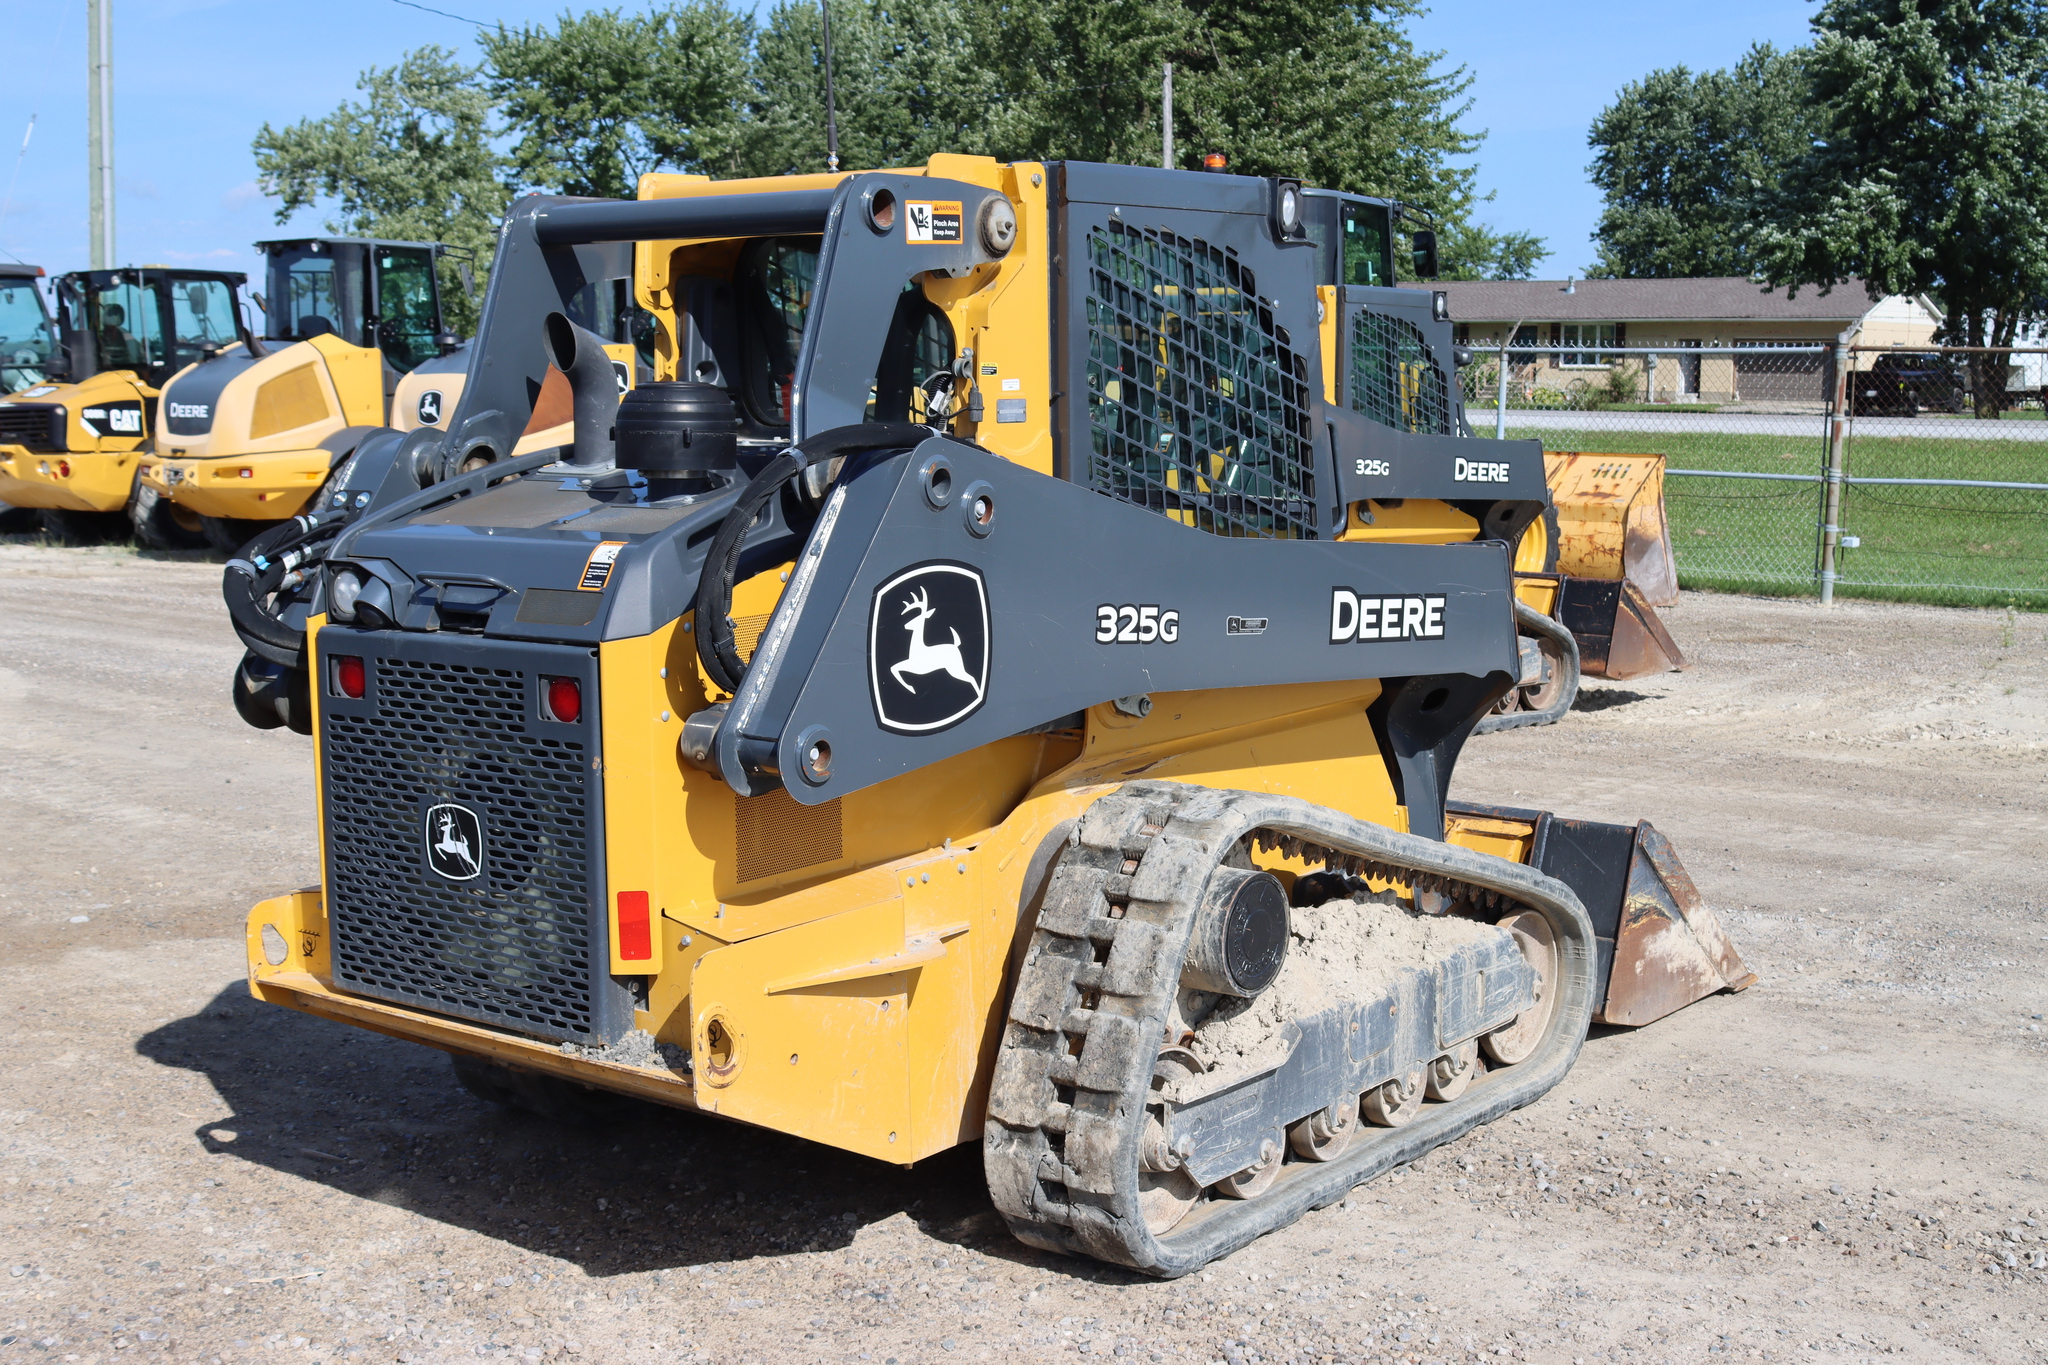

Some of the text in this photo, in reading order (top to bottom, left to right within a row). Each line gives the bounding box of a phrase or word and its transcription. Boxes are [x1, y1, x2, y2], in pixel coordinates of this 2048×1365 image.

[110, 409, 141, 431] CAT
[169, 402, 209, 418] DEERE
[1355, 458, 1390, 476] 325G
[1454, 456, 1510, 483] DEERE
[1096, 604, 1179, 643] 325G
[1330, 588, 1446, 642] DEERE
